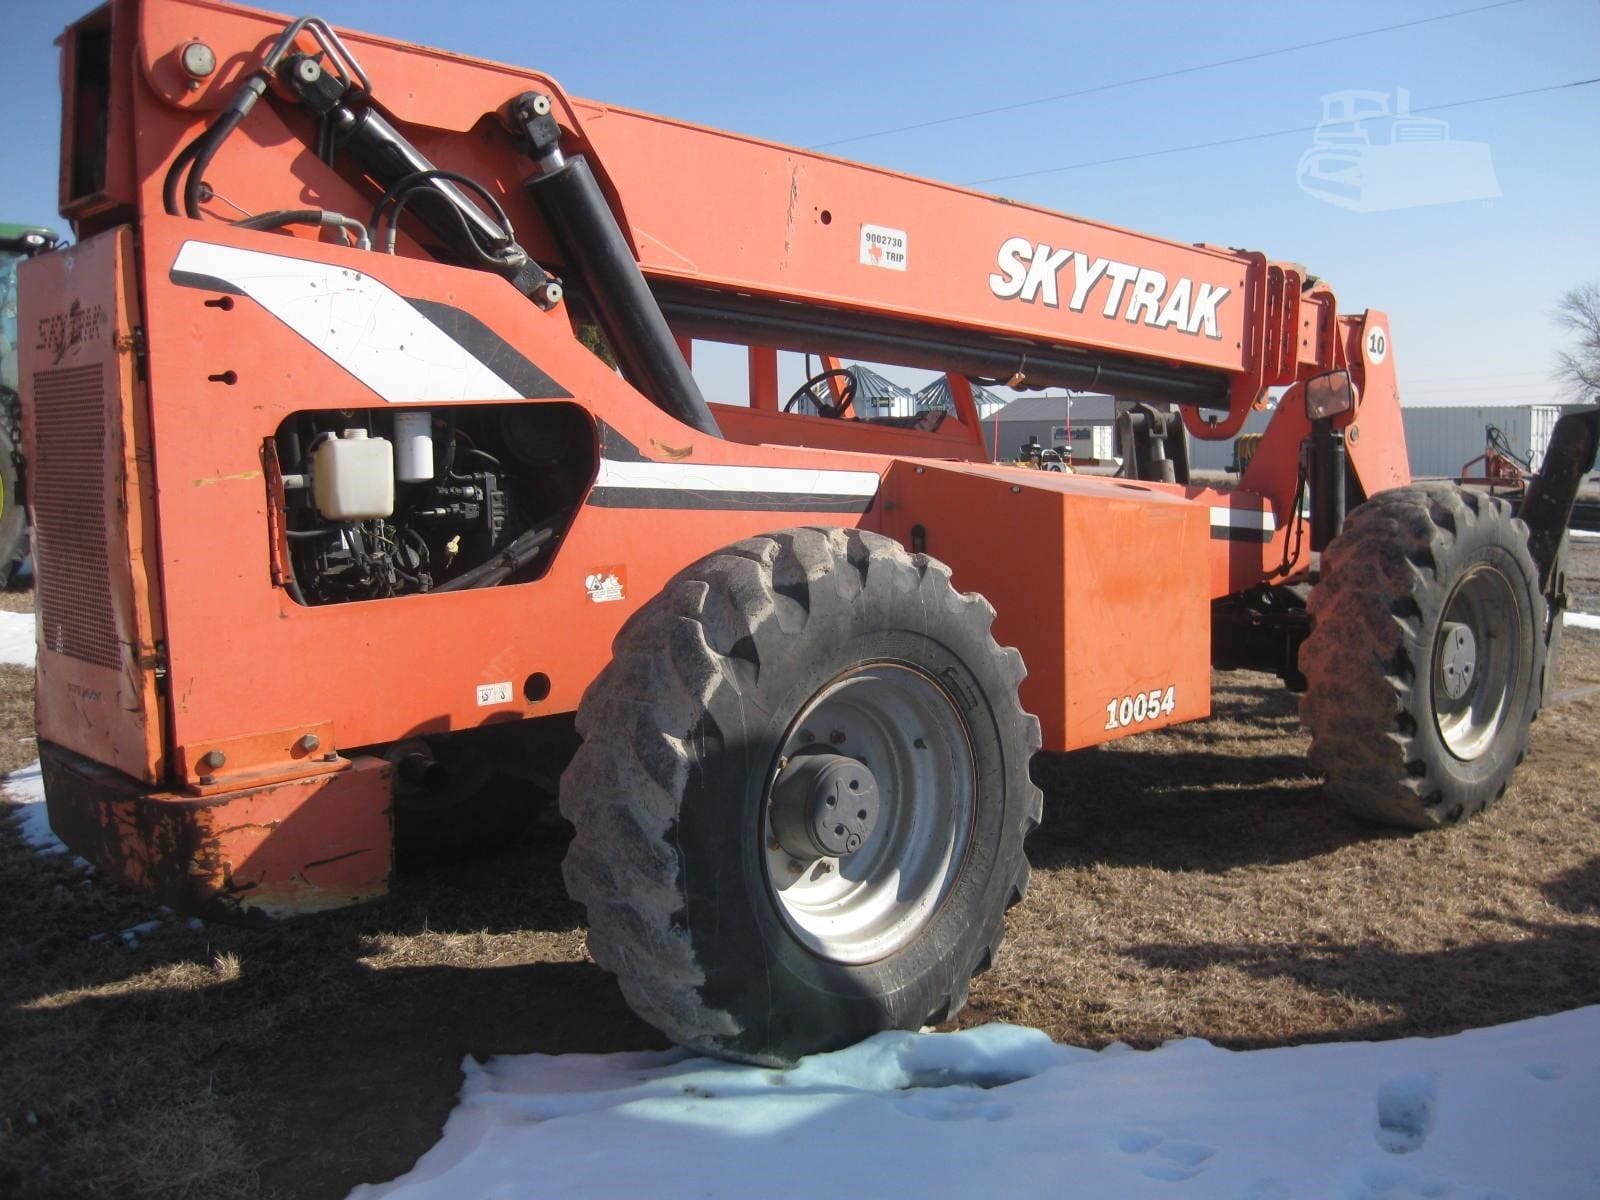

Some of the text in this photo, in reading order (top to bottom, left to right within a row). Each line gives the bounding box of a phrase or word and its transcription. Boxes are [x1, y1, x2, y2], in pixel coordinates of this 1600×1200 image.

[865, 232, 903, 249] 9002730
[886, 251, 904, 263] TRIP
[989, 237, 1231, 340] SKYTRAK
[1369, 333, 1385, 355] 10
[1104, 684, 1176, 731] 10054
